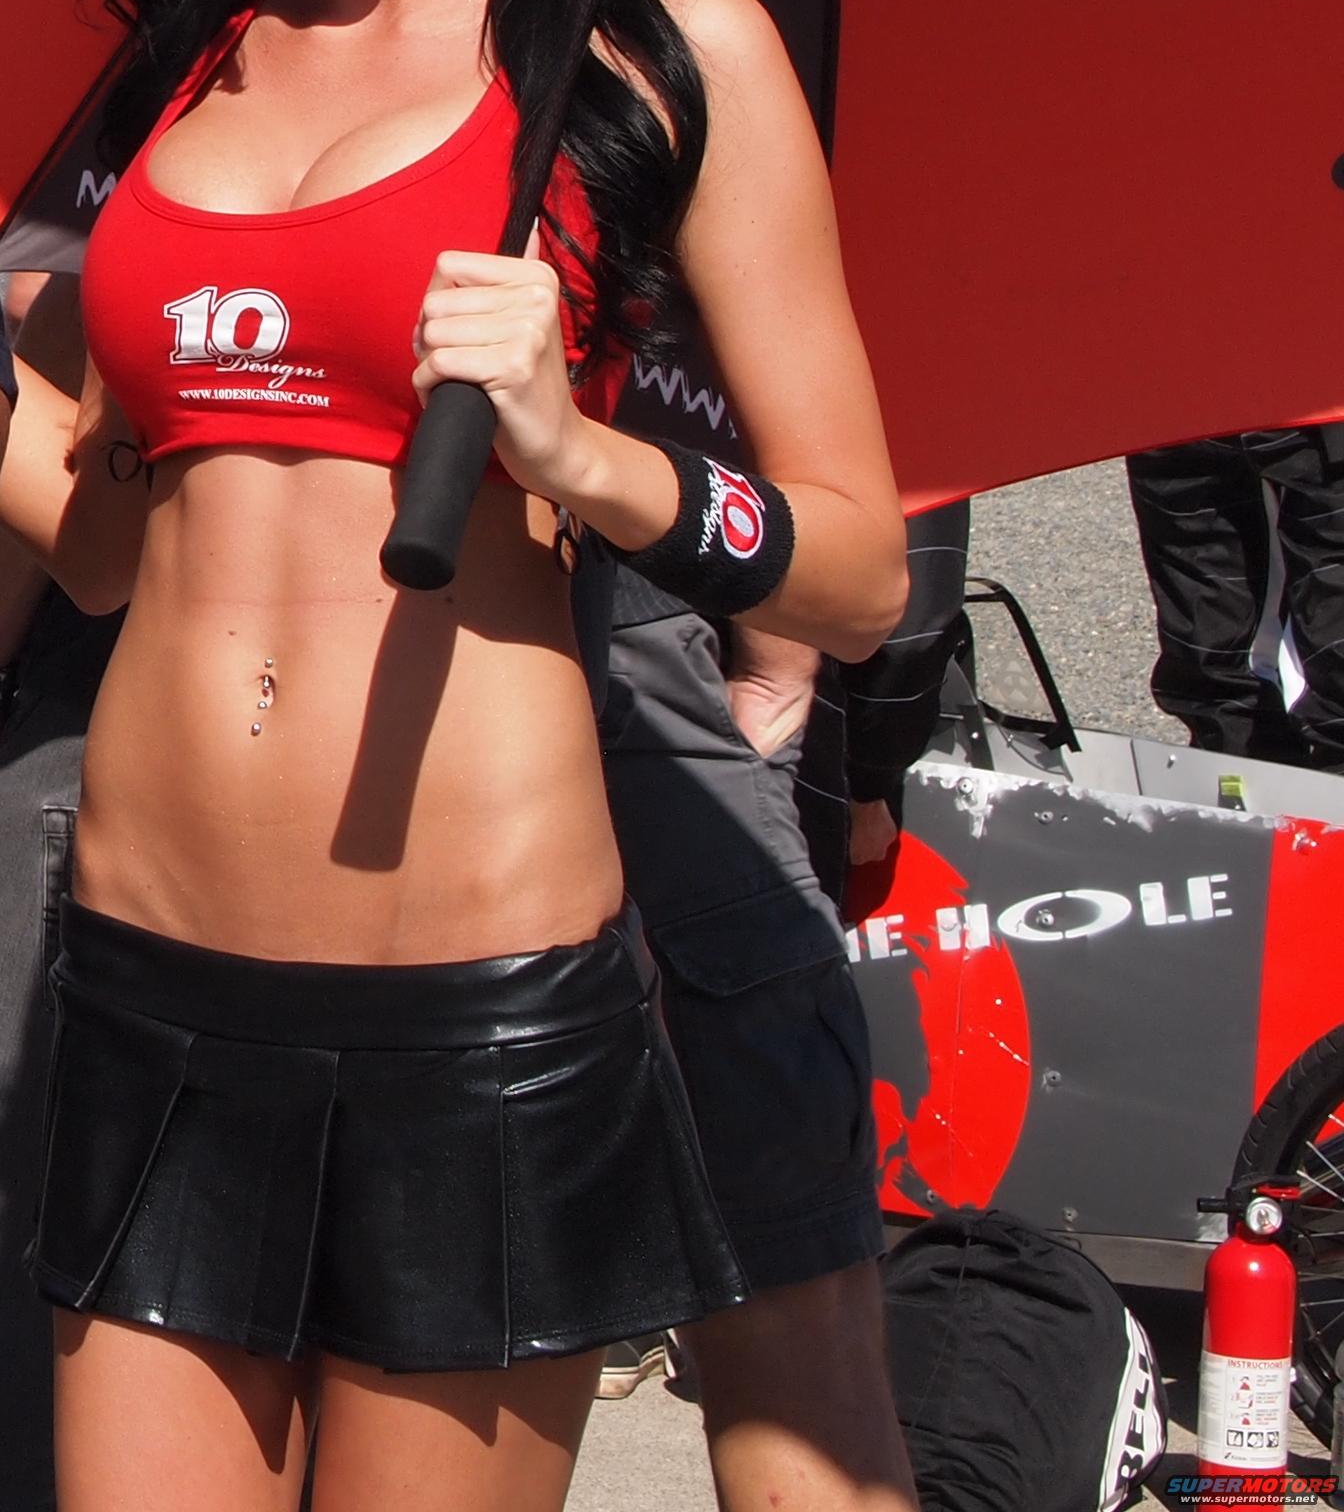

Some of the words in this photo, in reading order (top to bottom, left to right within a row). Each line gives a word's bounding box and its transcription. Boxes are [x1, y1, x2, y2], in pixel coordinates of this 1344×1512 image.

[163, 286, 291, 365] 10
[215, 353, 328, 389] Designs
[178, 388, 330, 408] WWW.10DESIGNSINC.COM
